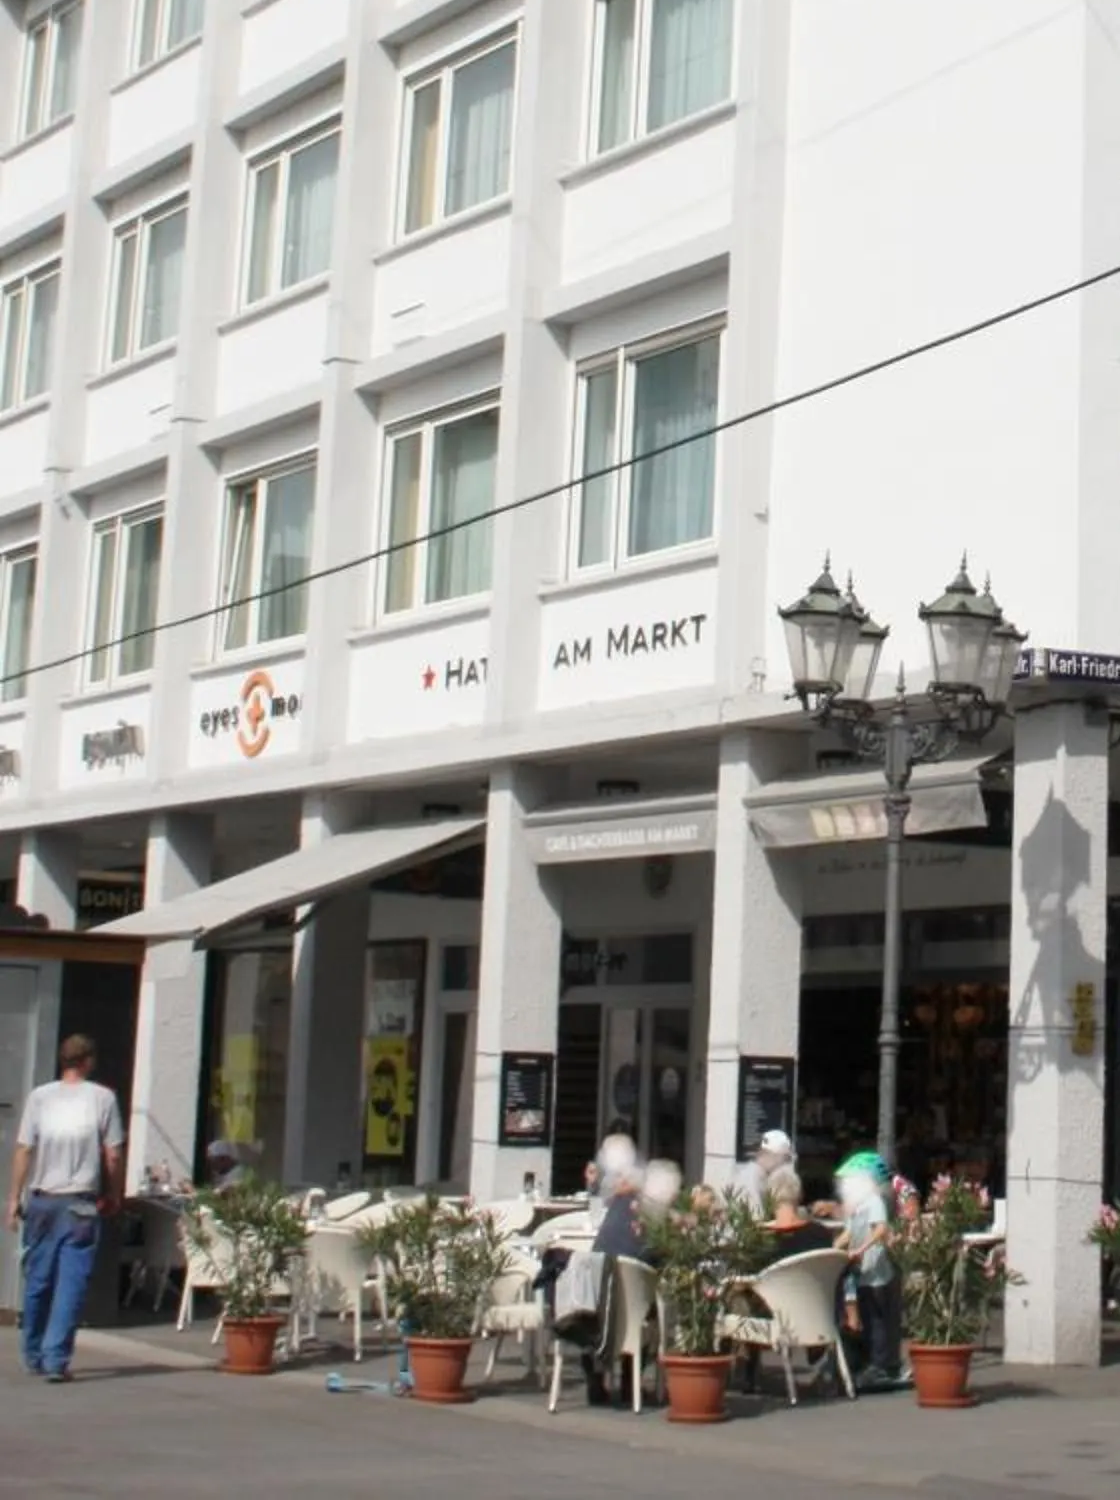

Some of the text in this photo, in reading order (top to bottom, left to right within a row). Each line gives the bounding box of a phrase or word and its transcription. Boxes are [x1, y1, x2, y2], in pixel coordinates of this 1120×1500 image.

[445, 613, 707, 691] HAT AM MARKT
[200, 693, 303, 739] eyes mo
